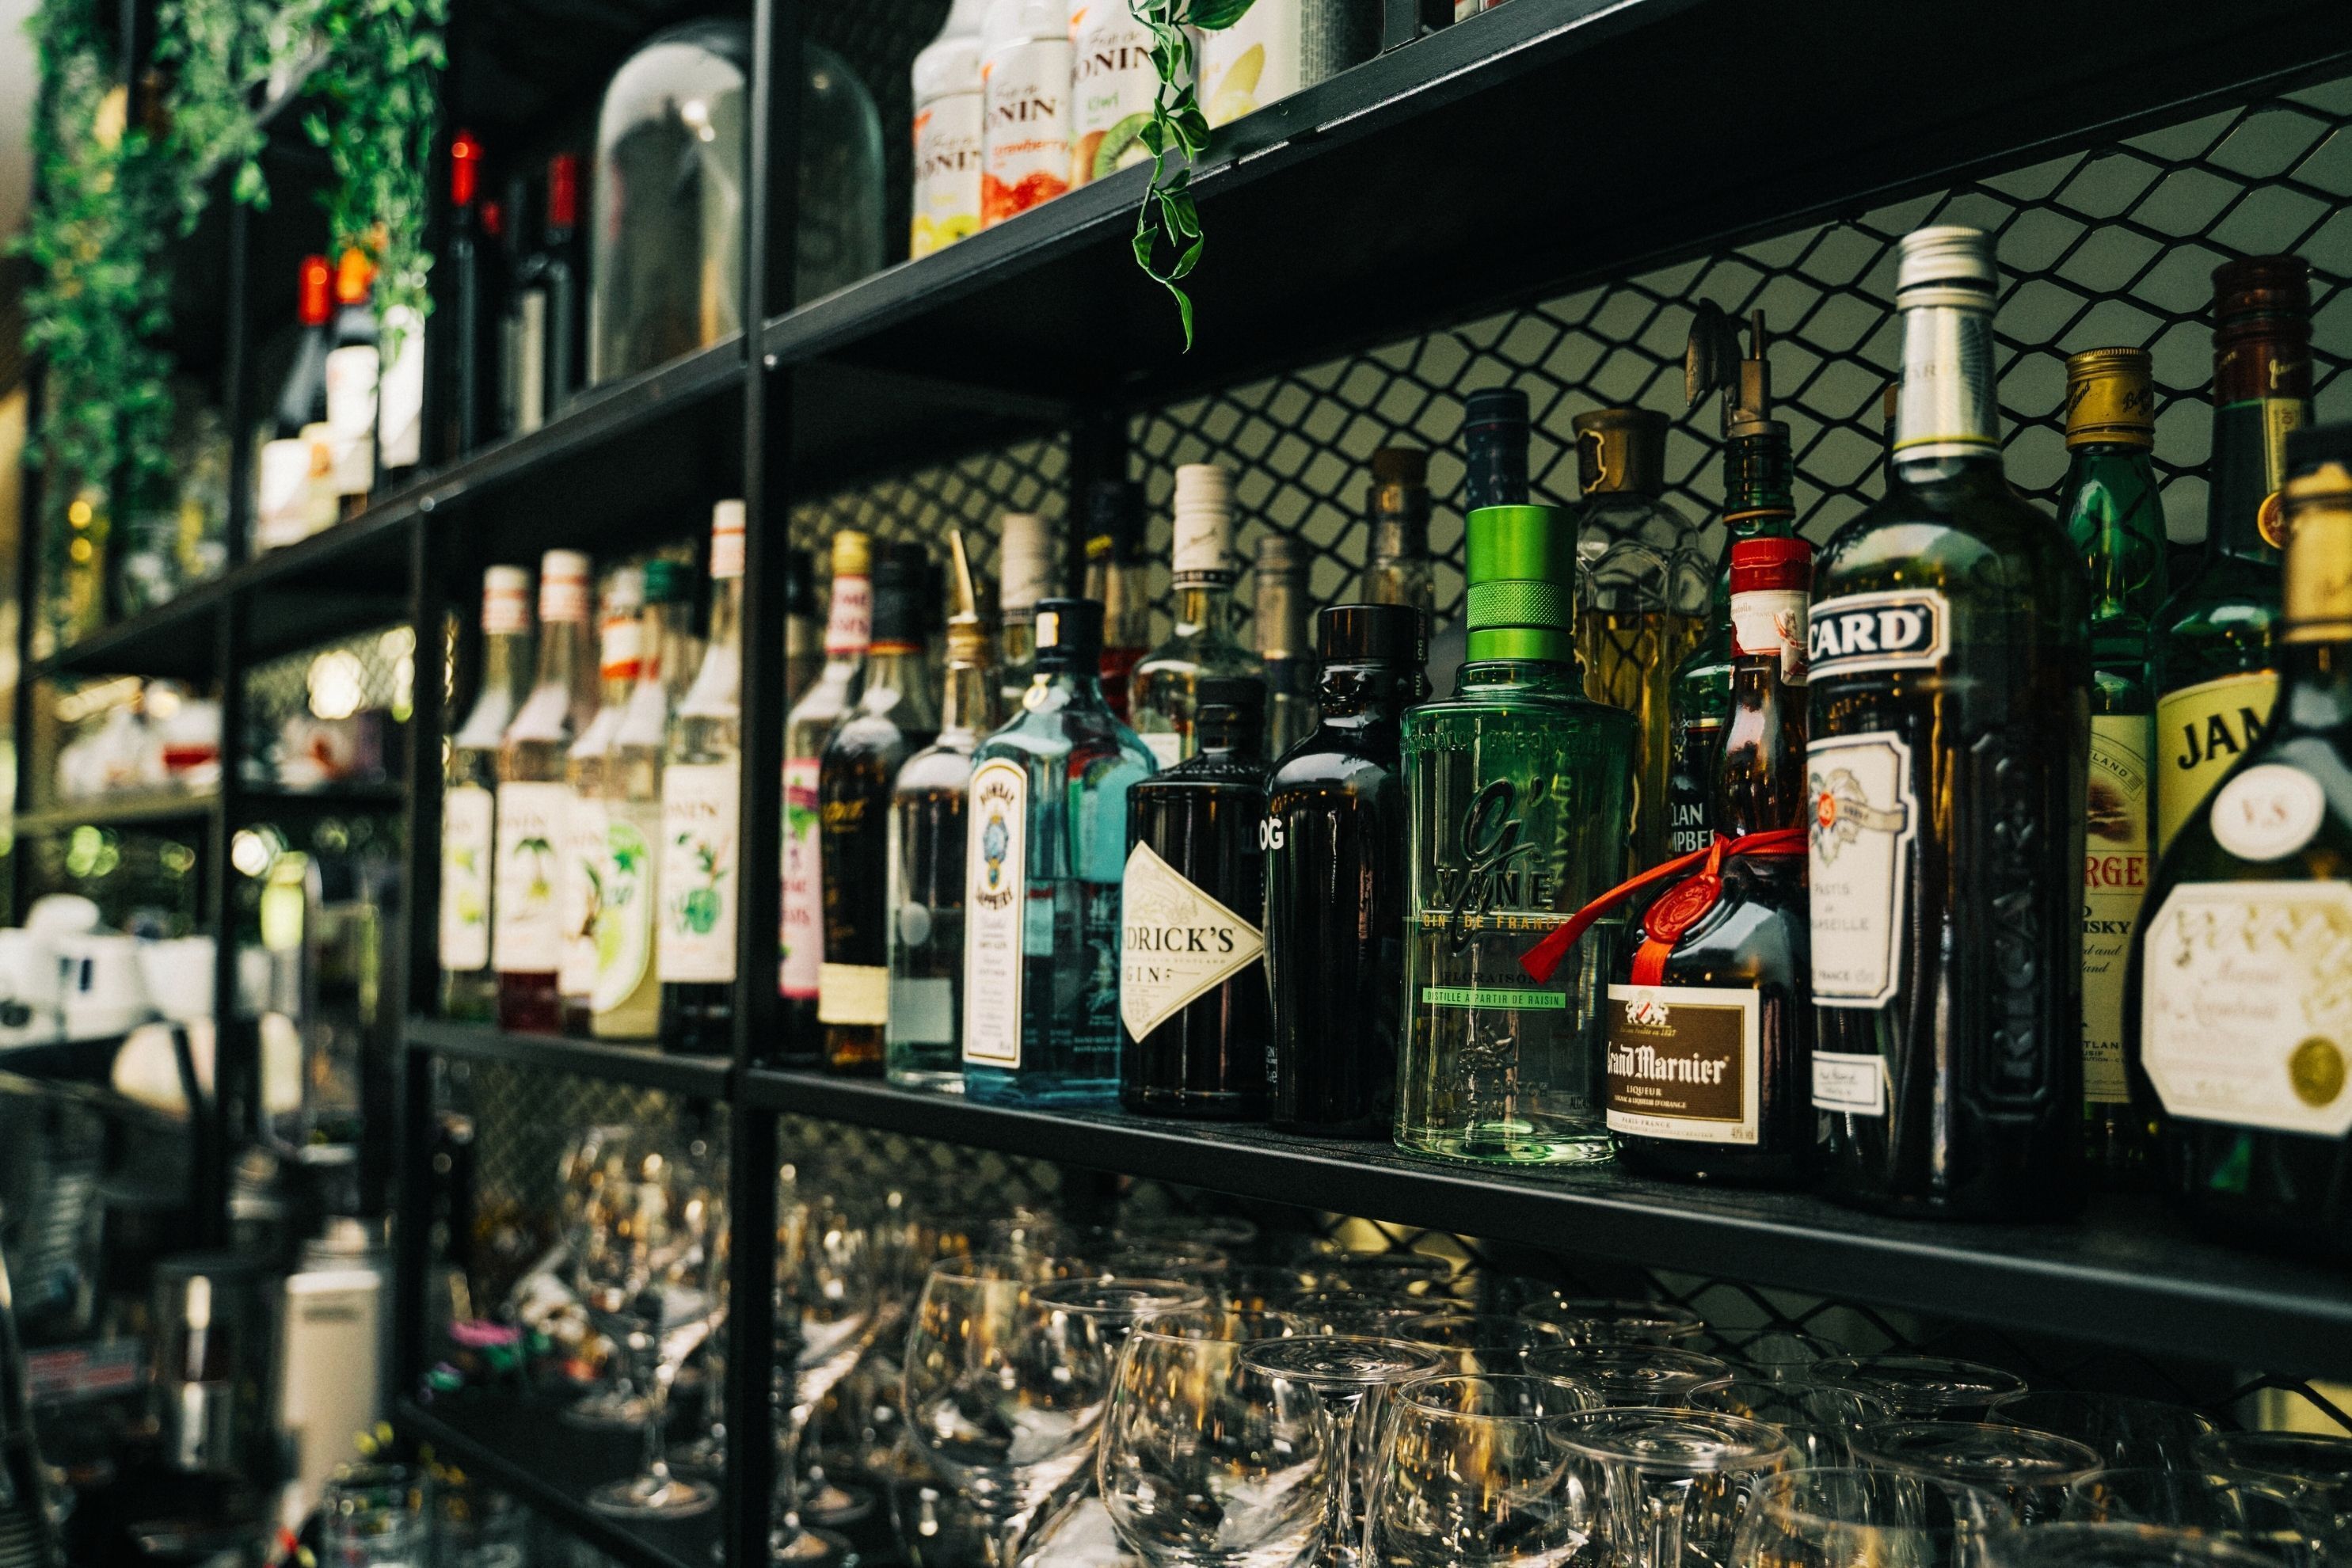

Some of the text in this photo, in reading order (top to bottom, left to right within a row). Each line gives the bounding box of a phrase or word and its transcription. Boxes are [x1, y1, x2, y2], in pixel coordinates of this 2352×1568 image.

[1808, 609, 1922, 662] CARD
[2091, 752, 2129, 778] LAND
[1423, 913, 1446, 928] GIN
[1464, 915, 1484, 930] DE
[1127, 926, 1235, 953] DRICK'S
[1475, 992, 1508, 1004] PARTIR
[1512, 994, 1524, 1004] DE
[1528, 995, 1560, 1006] RAISIN
[1635, 1045, 1727, 1086] Marnier
[1626, 1084, 1662, 1097] LIQUEUR
